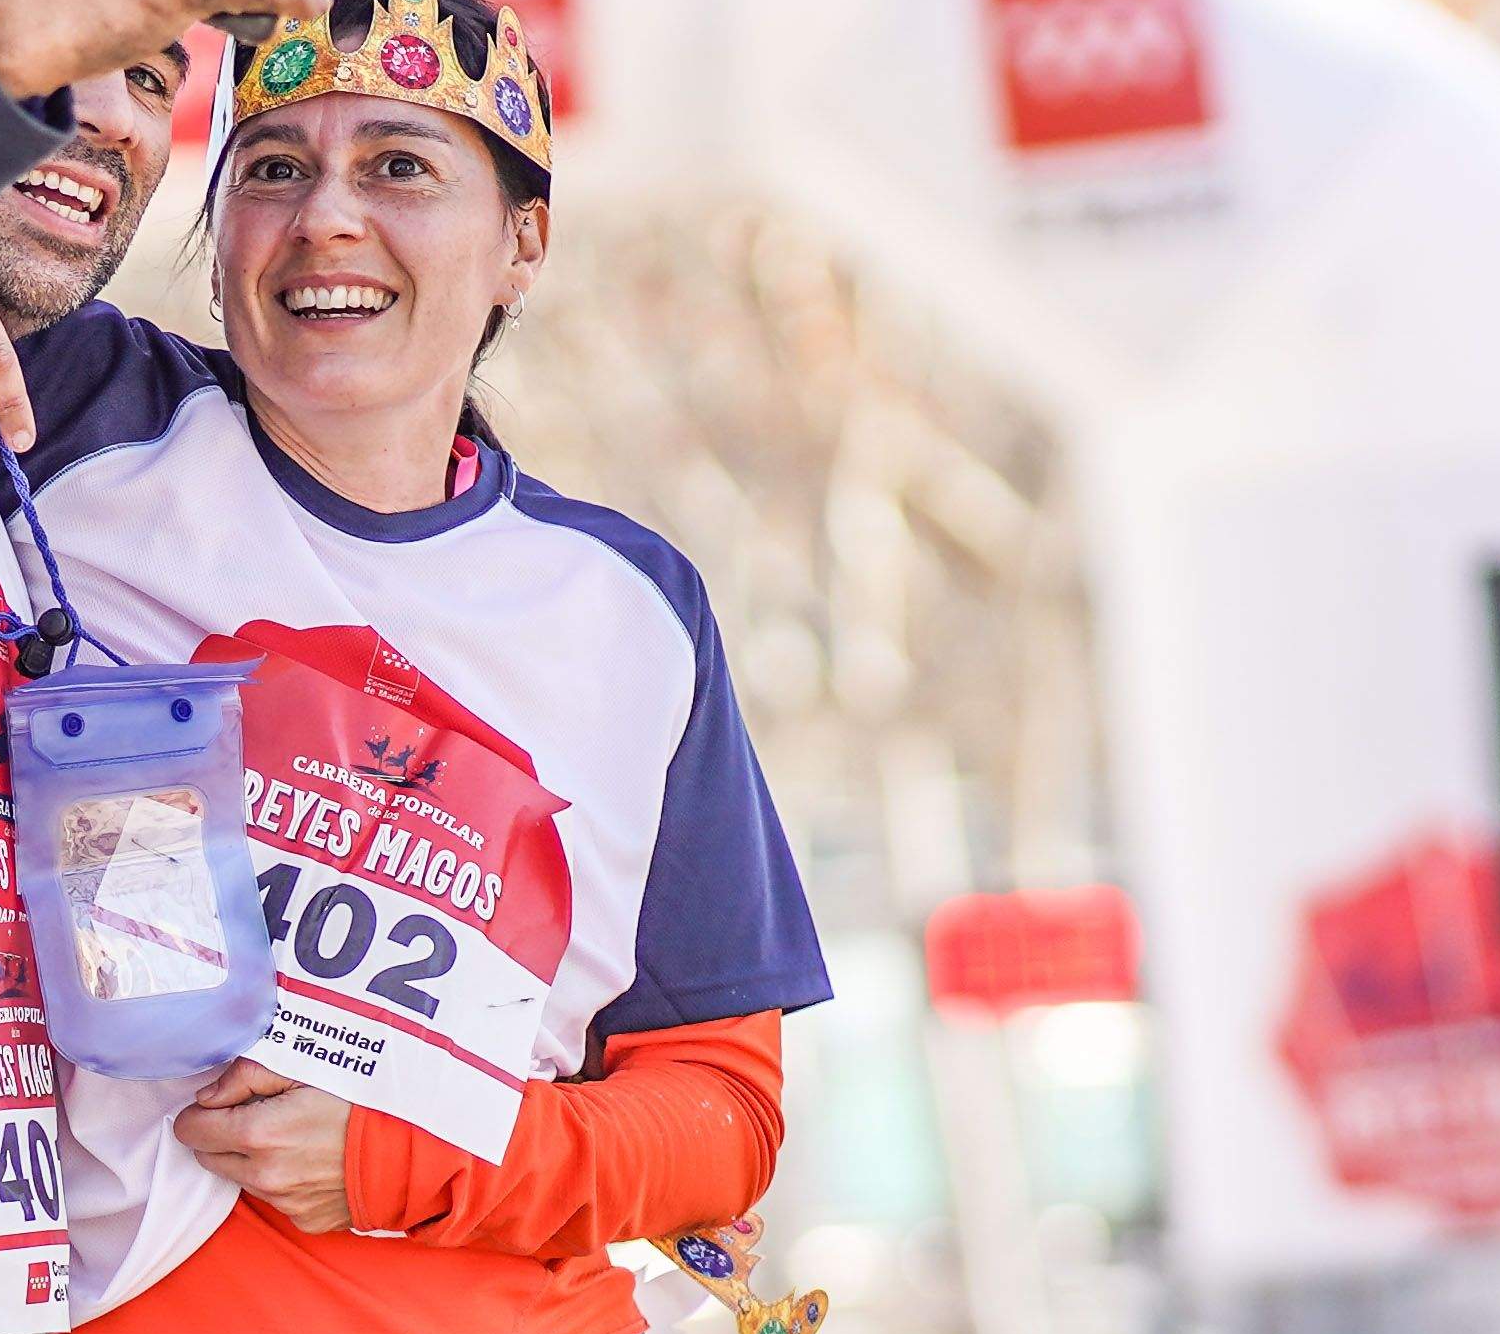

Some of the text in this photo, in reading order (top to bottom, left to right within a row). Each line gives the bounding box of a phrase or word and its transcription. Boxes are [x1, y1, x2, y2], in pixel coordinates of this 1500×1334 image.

[378, 689, 412, 706] Madrid
[292, 755, 485, 851] CARRERA POPULAR
[367, 805, 400, 821] de los
[244, 767, 502, 921] REYES MAGOS
[256, 862, 458, 1020] 402
[17, 1043, 53, 1098] MAG
[292, 1036, 377, 1077] Madrid
